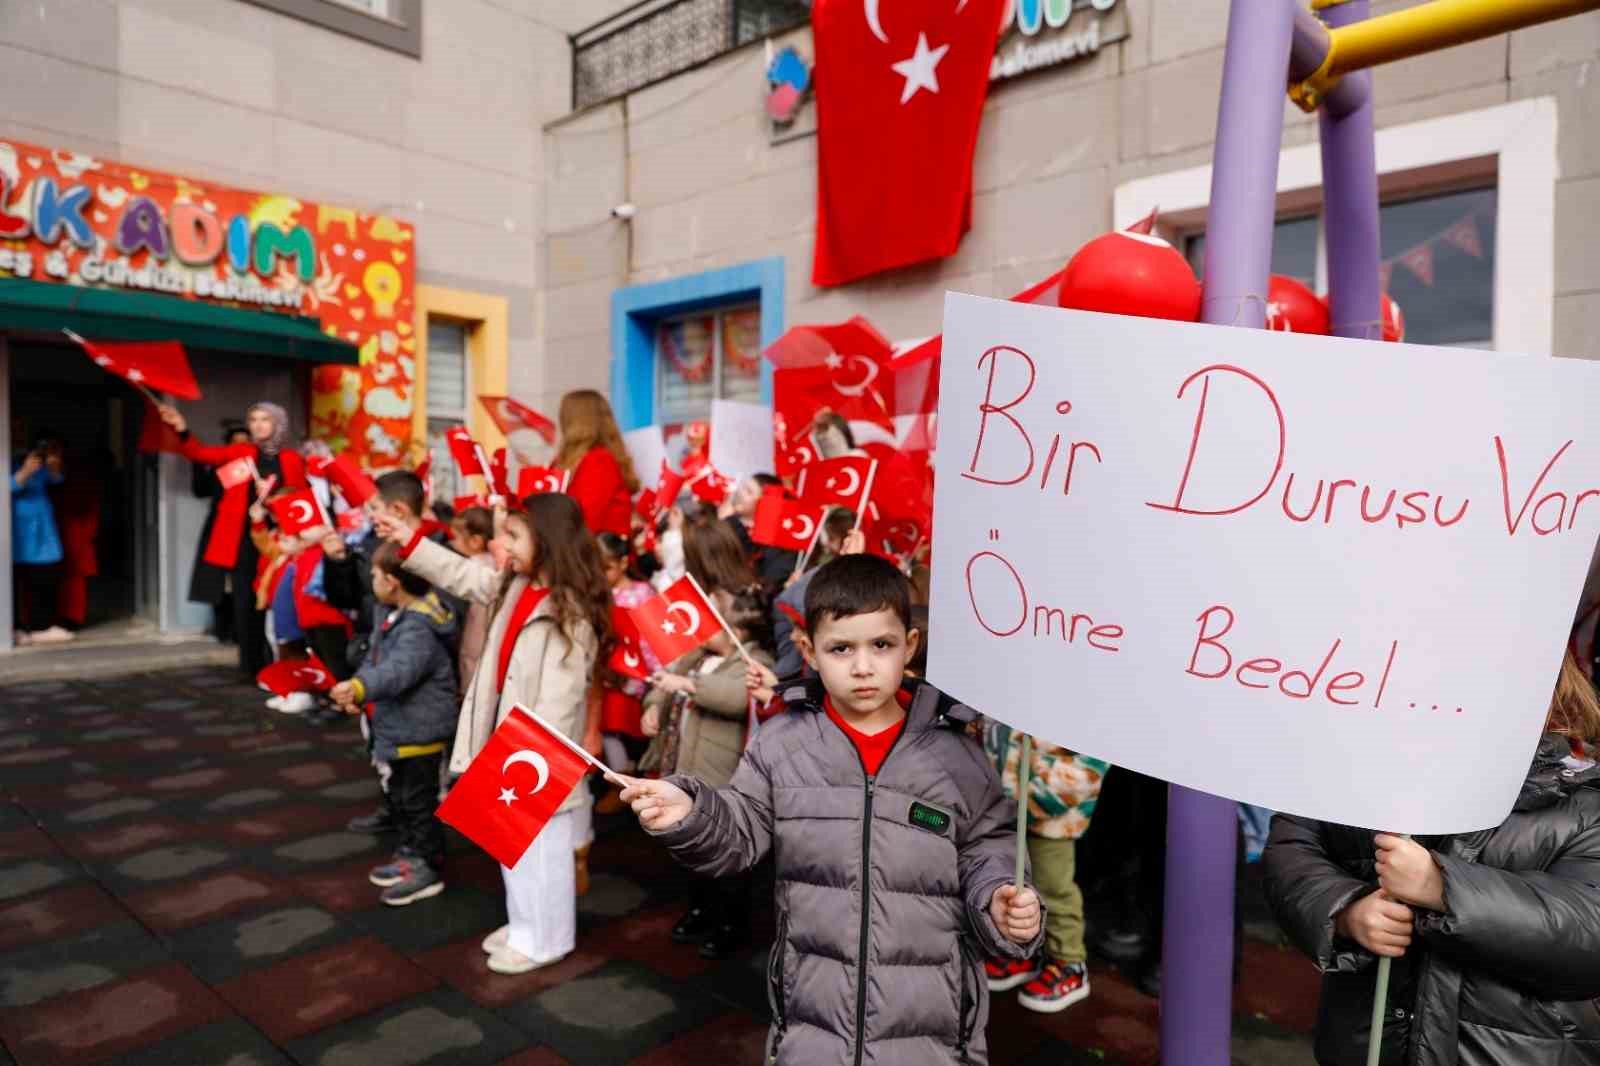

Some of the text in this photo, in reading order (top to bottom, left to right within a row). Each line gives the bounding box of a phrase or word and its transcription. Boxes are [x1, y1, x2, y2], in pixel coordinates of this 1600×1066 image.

[117, 197, 316, 281] ADIM
[961, 345, 1102, 495] Bir
[1494, 435, 1600, 536] Var
[965, 527, 1124, 652] Ömre
